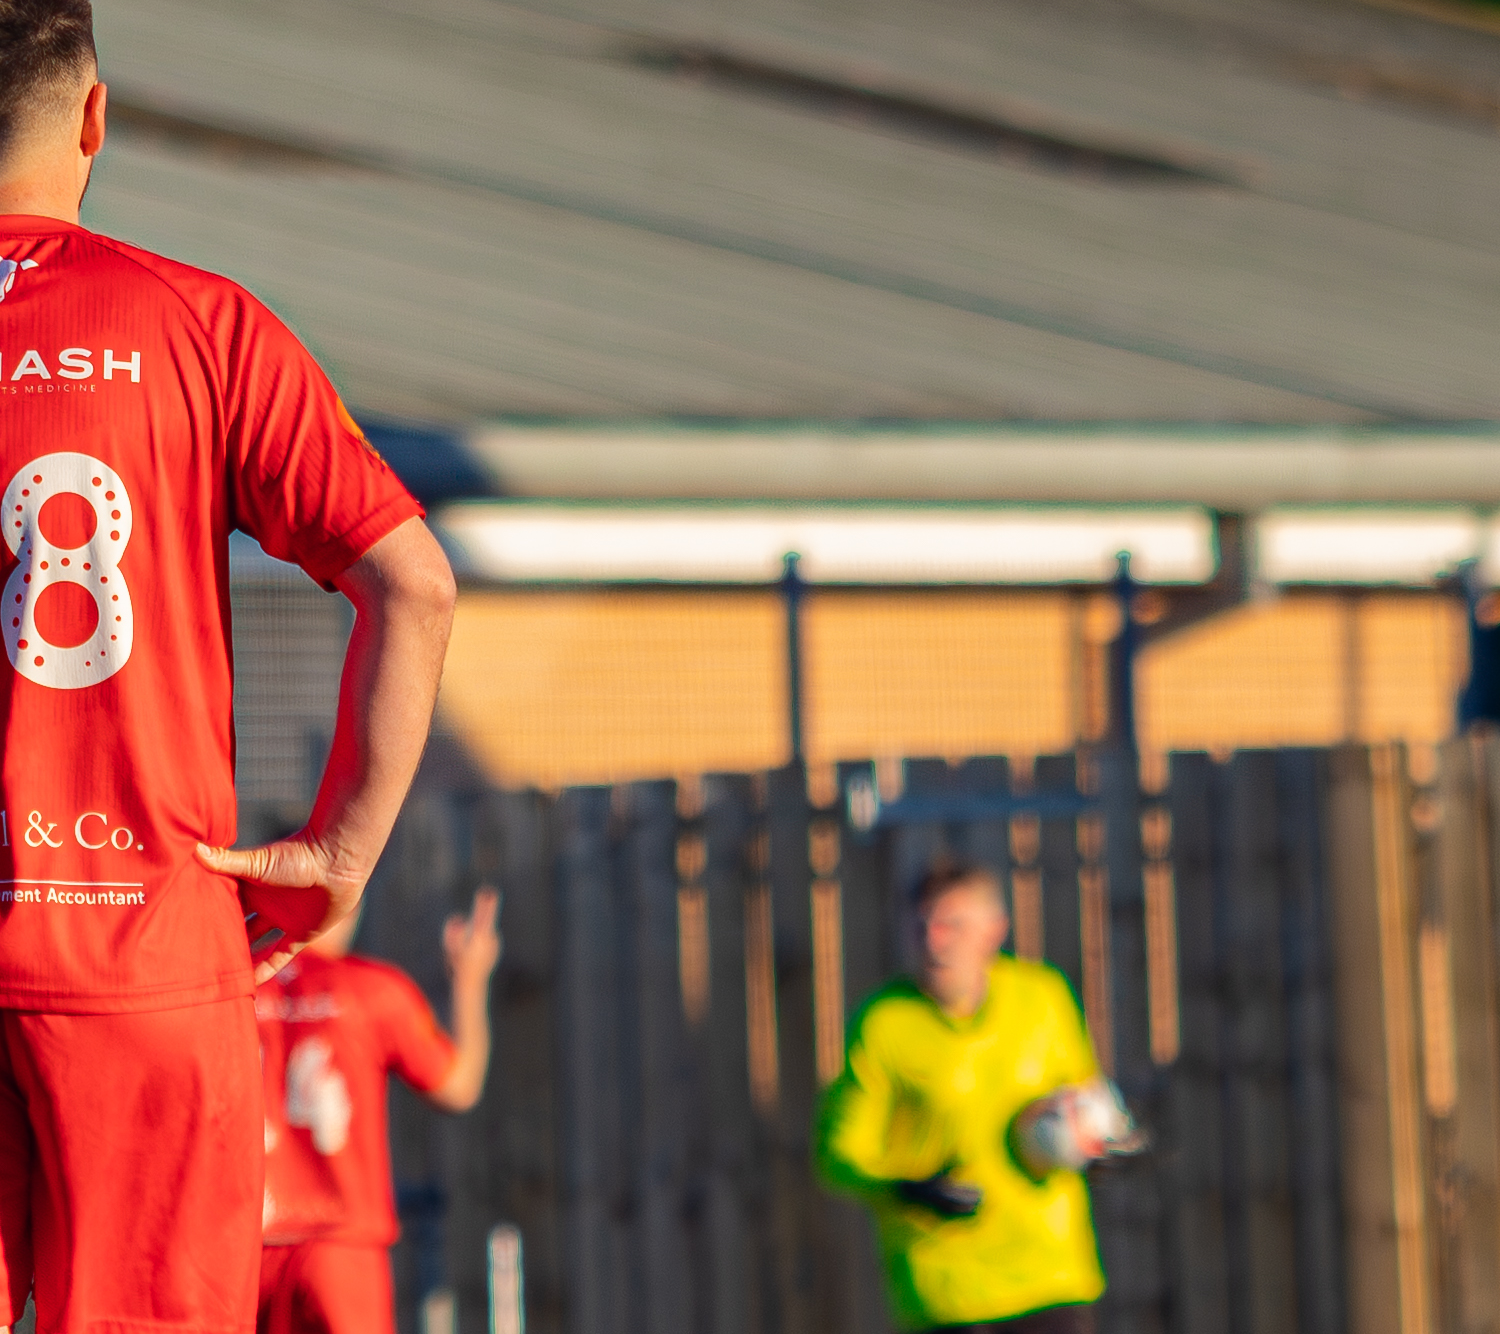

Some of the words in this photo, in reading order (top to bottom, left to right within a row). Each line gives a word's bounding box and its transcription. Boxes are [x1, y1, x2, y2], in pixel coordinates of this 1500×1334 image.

[24, 383, 96, 394] MEDICINE
[24, 810, 63, 848] &
[74, 812, 144, 851] Co.
[46, 887, 146, 906] Accountant
